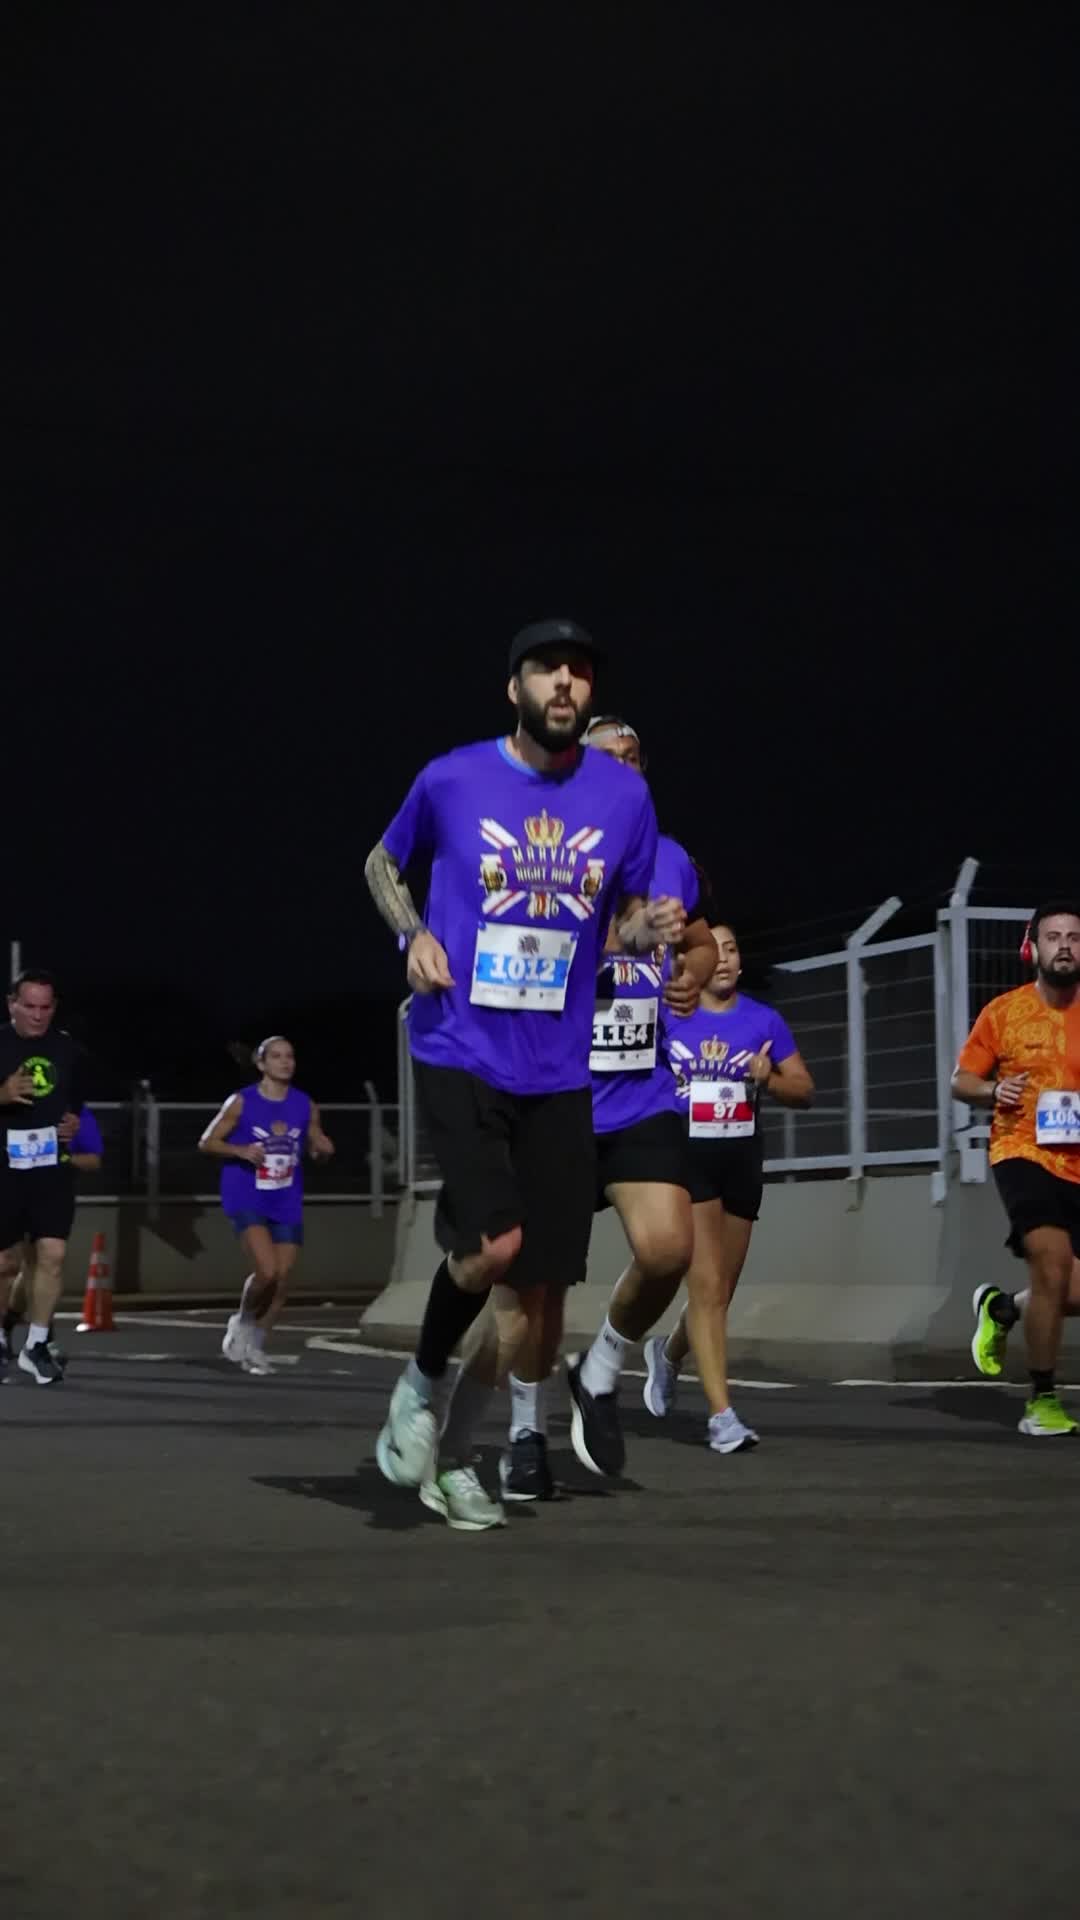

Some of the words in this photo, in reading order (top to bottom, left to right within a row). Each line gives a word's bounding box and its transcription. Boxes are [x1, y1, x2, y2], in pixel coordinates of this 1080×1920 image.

[551, 867, 574, 885] RUN
[490, 956, 556, 982] 1012
[592, 1023, 648, 1046] 1154
[713, 1102, 737, 1119] 97
